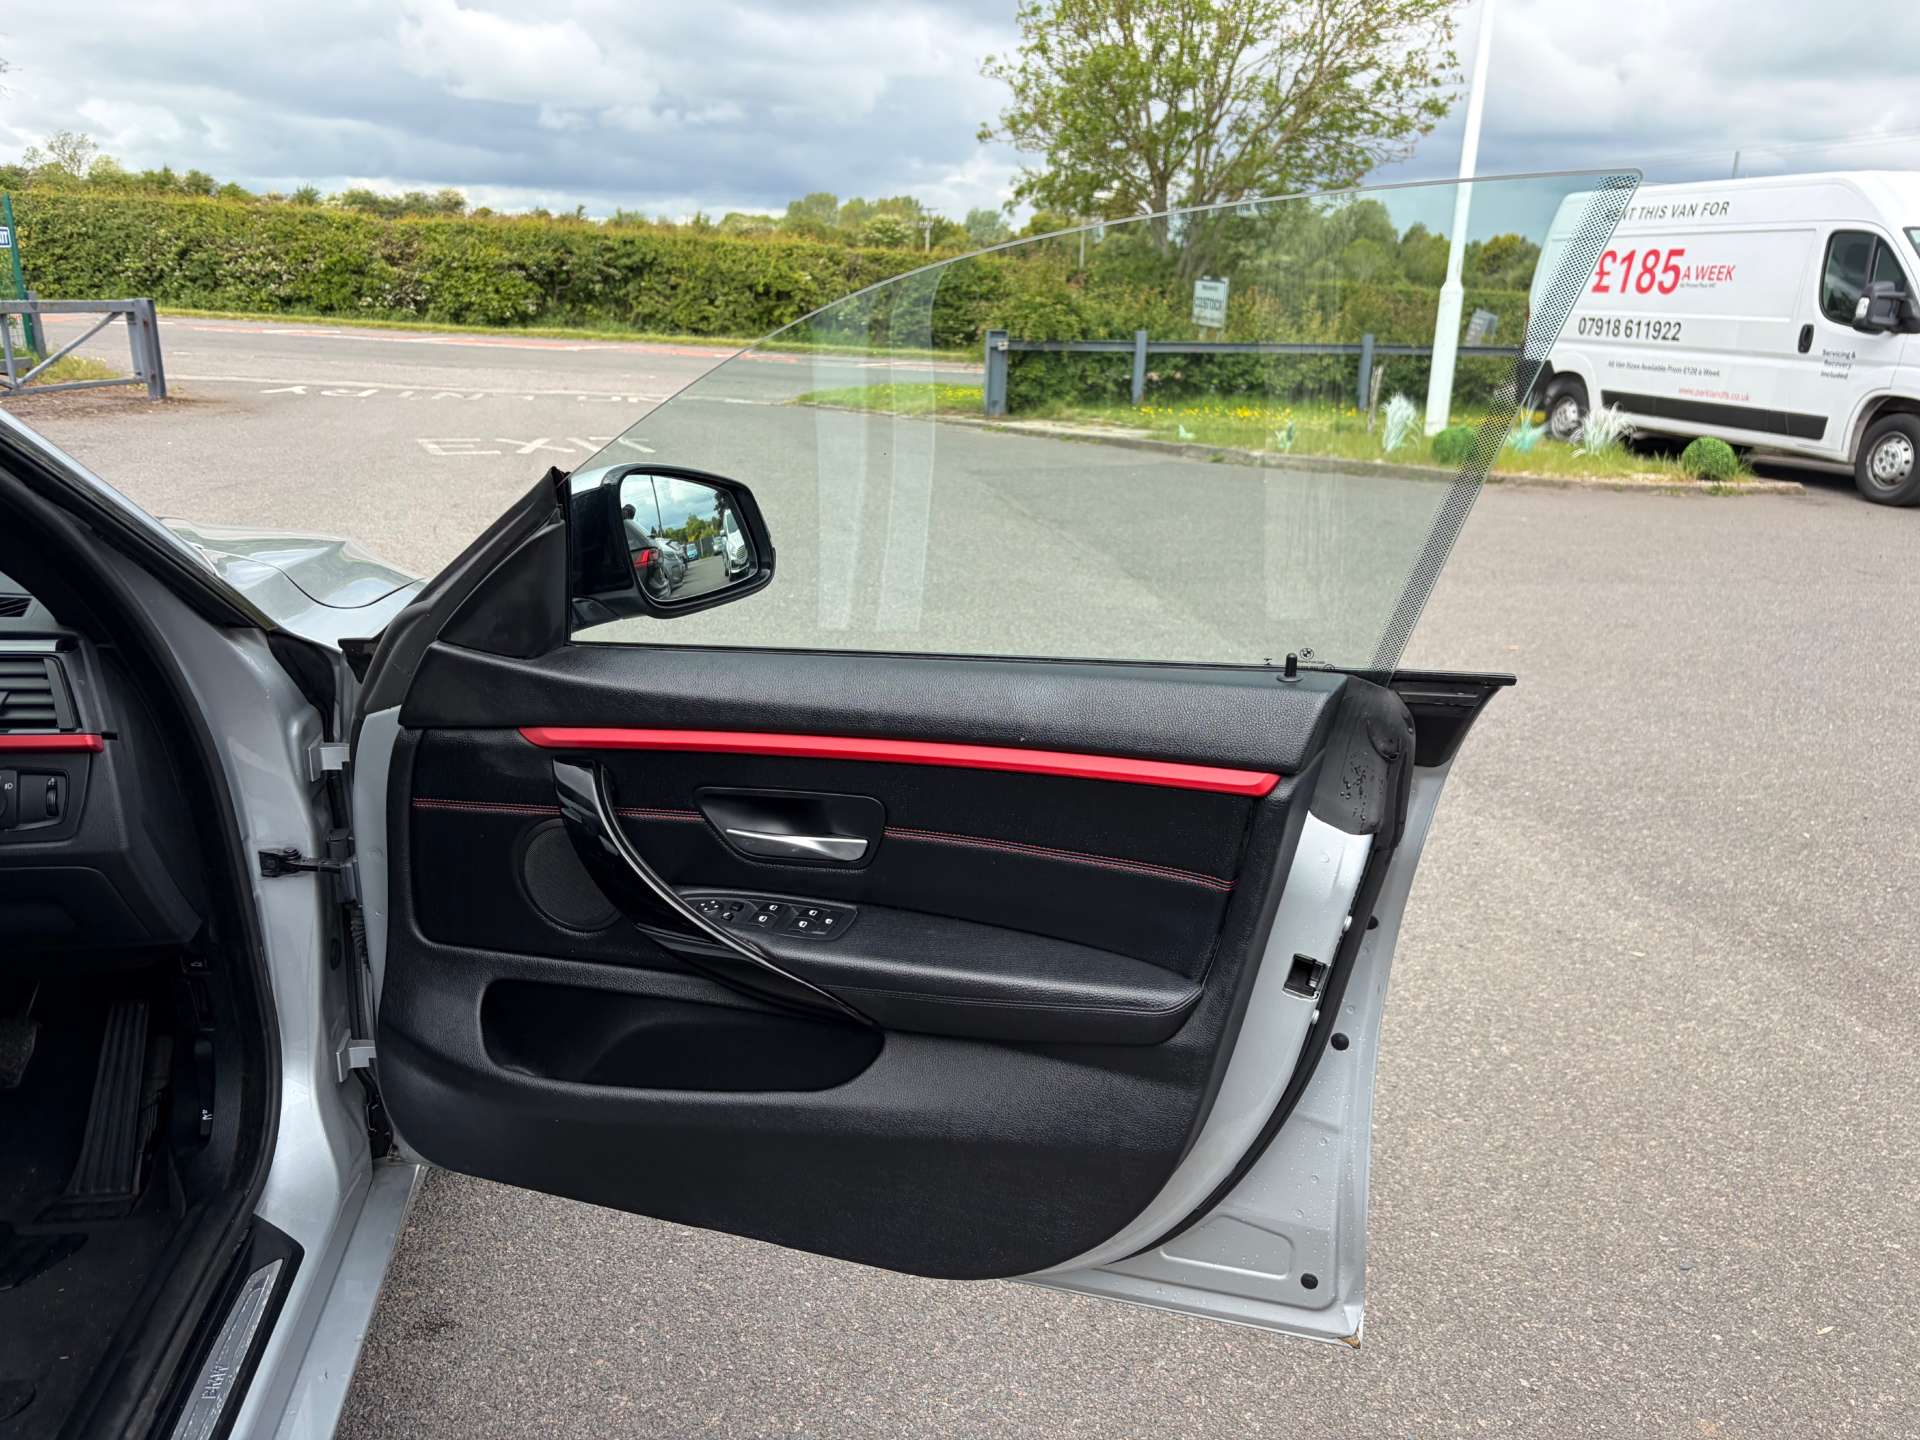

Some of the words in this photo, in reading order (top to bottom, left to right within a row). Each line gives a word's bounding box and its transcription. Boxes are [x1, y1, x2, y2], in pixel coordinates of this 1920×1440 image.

[1638, 206, 1667, 220] THIS
[1671, 203, 1699, 218] VAN
[1701, 201, 1730, 216] FOR
[1591, 248, 1685, 295] £185
[1681, 265, 1691, 281] A
[1696, 264, 1736, 281] WEEK
[1578, 317, 1621, 338] 07918
[1624, 319, 1682, 342] 611922
